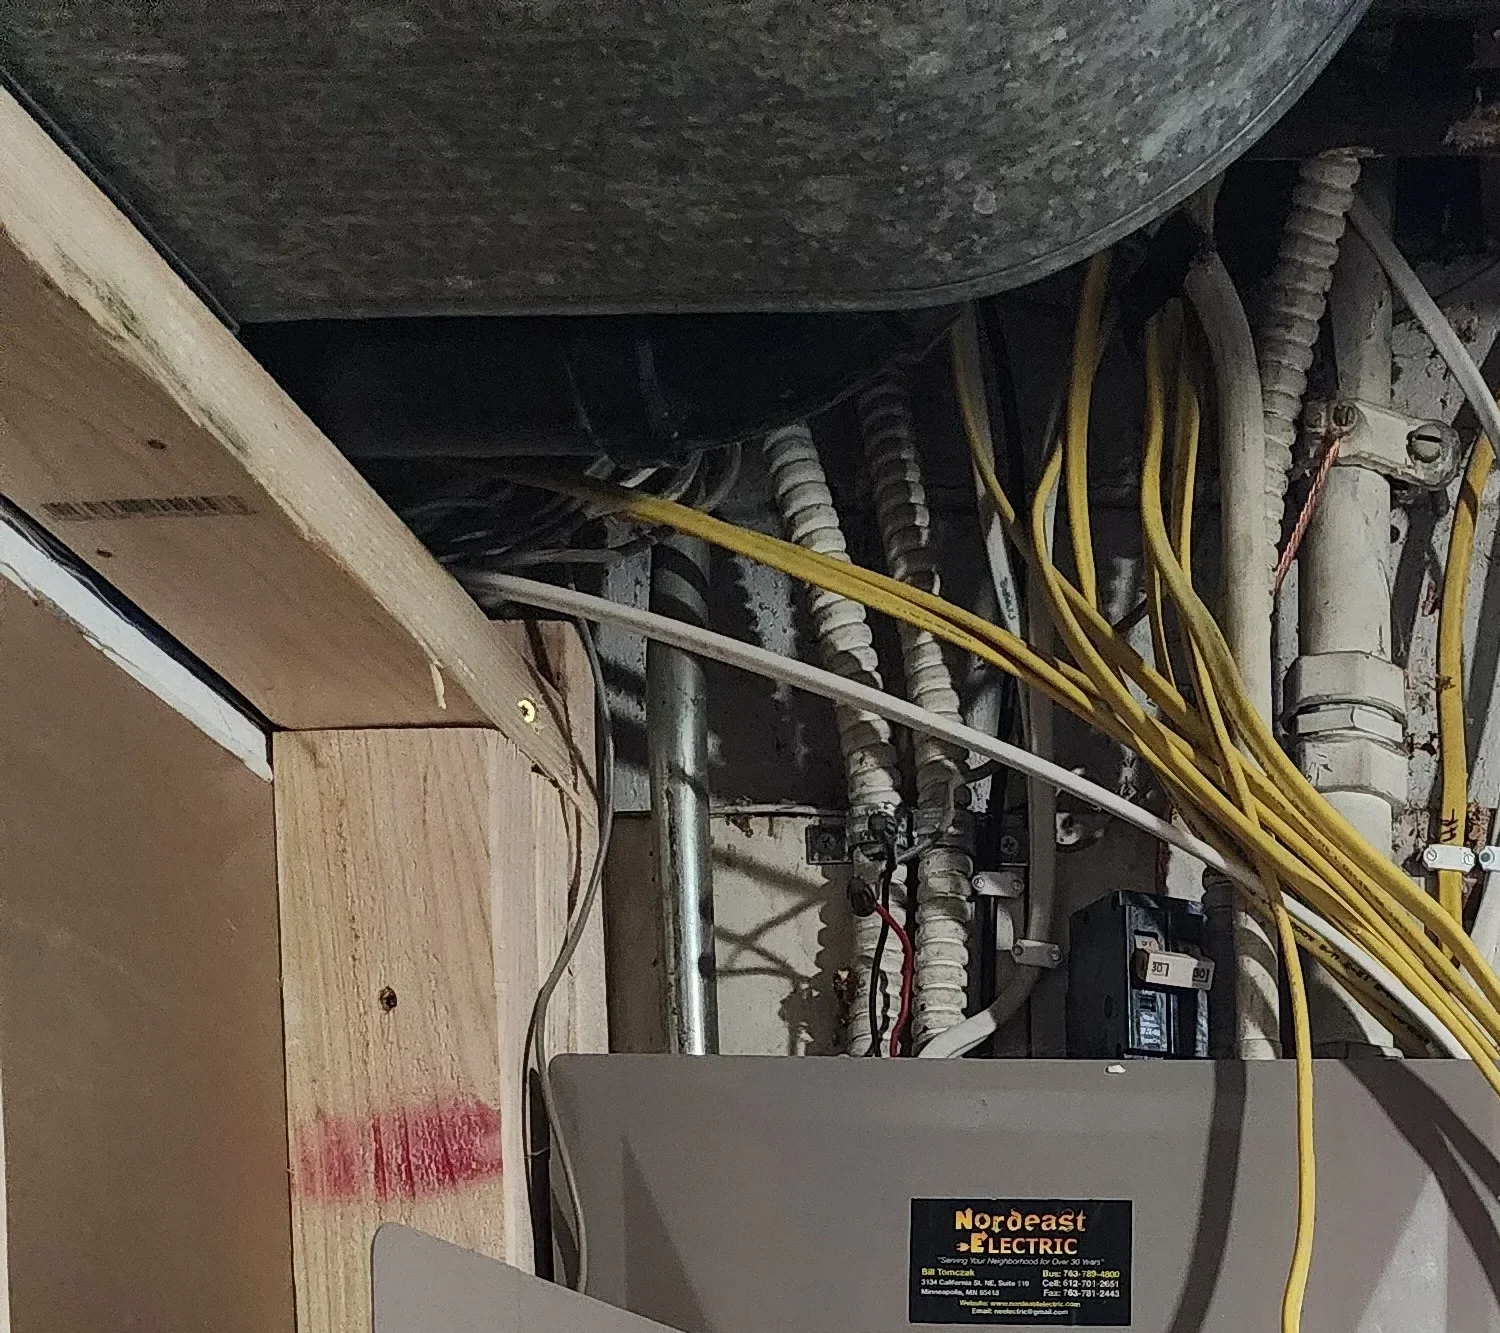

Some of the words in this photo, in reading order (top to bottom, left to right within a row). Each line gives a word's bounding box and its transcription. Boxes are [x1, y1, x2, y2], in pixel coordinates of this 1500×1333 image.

[955, 1207, 1087, 1233] Nordeast
[969, 1230, 1078, 1255] ELECTRIC
[970, 1257, 986, 1265] Your
[921, 1267, 935, 1276] Bill
[937, 1268, 975, 1277] Tomczak
